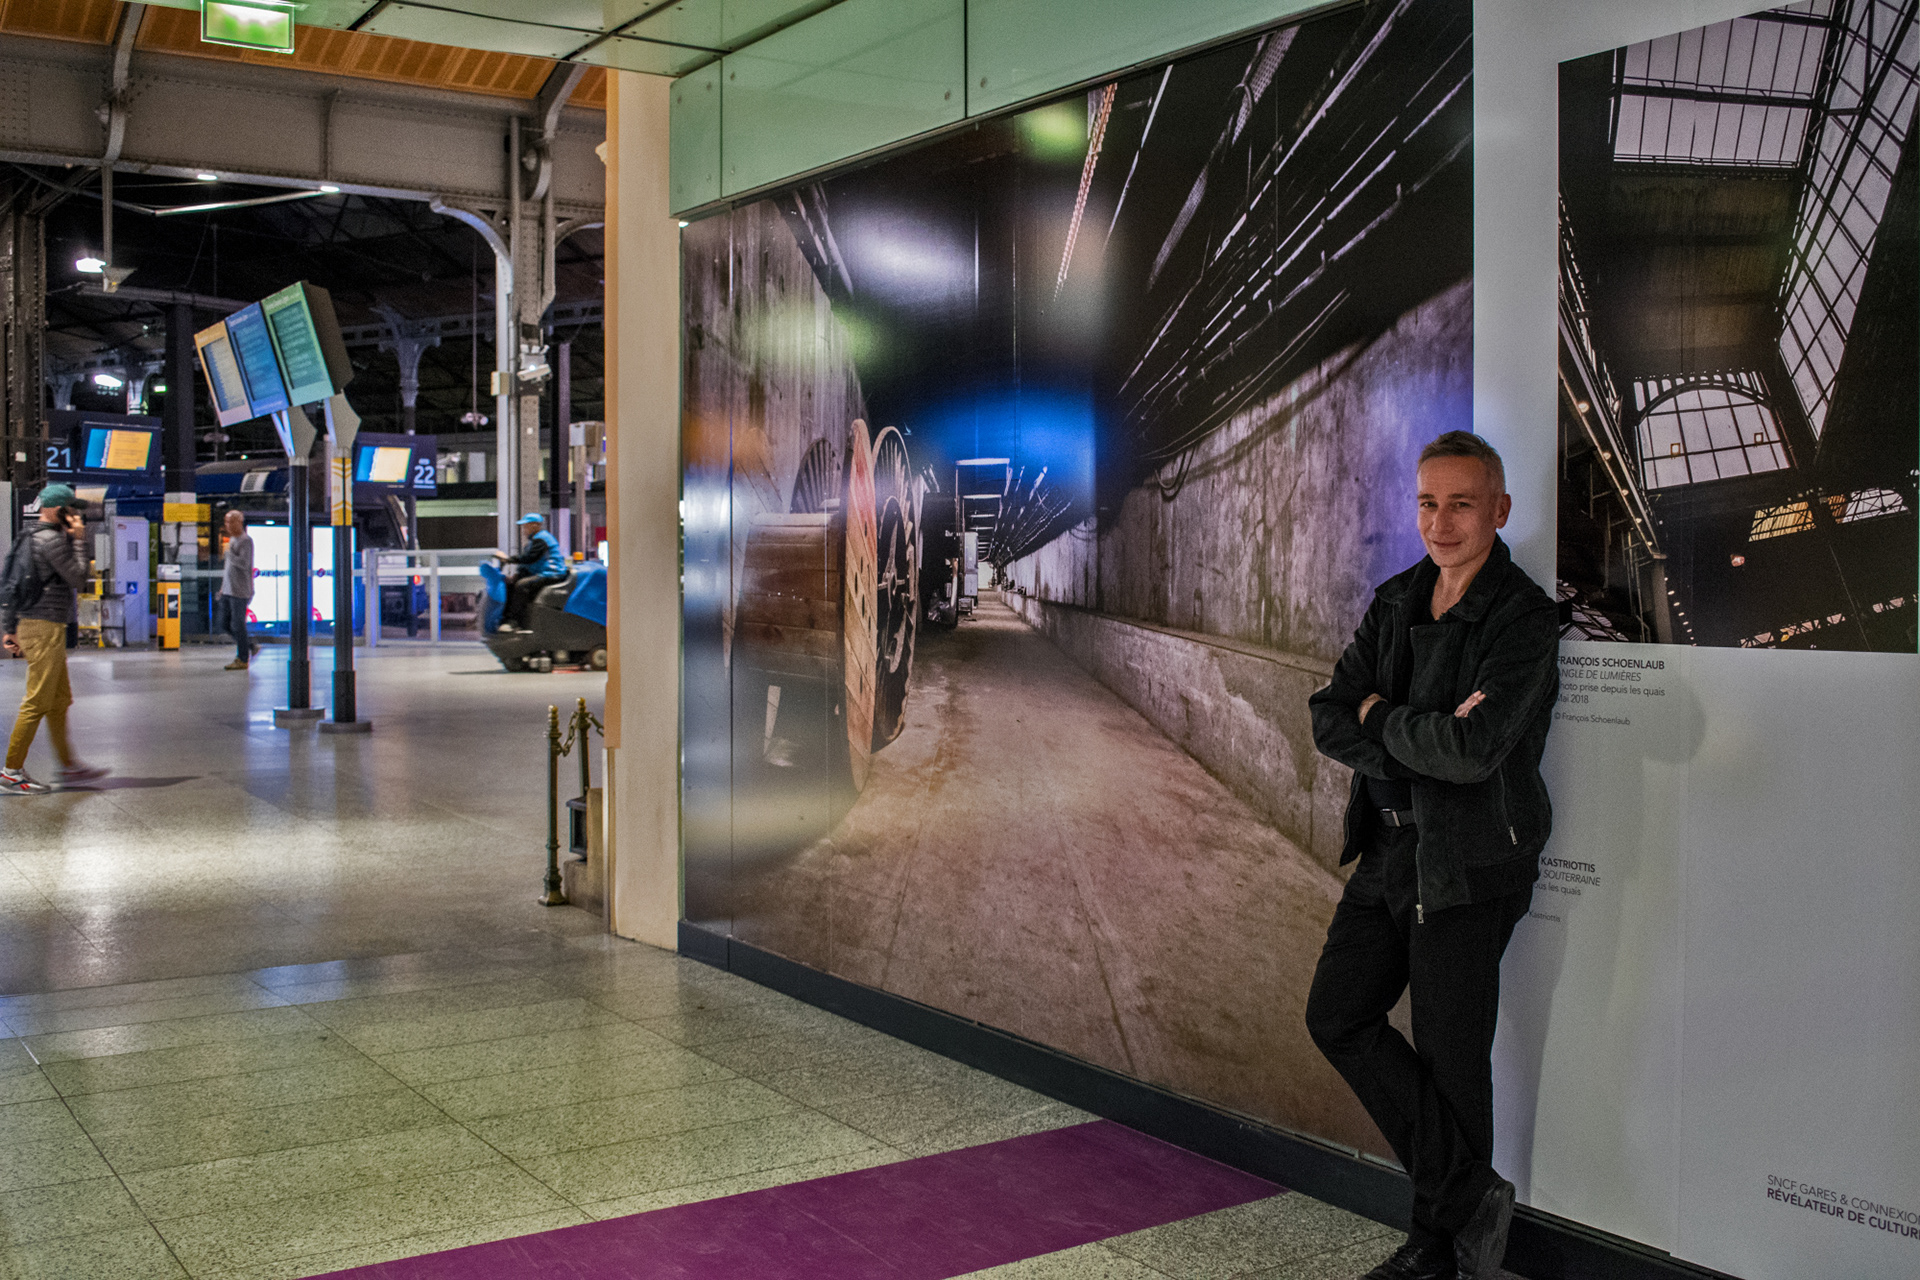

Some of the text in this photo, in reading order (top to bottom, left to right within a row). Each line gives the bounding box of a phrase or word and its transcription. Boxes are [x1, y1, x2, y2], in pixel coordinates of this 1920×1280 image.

[46, 446, 71, 468] 21
[414, 465, 435, 485] 22
[1602, 657, 1665, 670] SCHOENLAUB
[1560, 668, 1642, 681] NGLE DE LUMIÈRES
[1580, 683, 1599, 693] prise
[1600, 684, 1628, 695] depuis
[1630, 685, 1641, 694] les
[1643, 686, 1665, 697] quais
[1570, 694, 1589, 704] 2018
[1591, 714, 1631, 725] Schoenlaub
[1540, 856, 1596, 873] KASTRIOTTIS
[1543, 869, 1601, 887] SOUTERRAINE
[1548, 882, 1560, 893] les
[1560, 886, 1582, 896] quais
[1767, 1174, 1920, 1226] SNCF GARES & CONNEXIO
[1767, 1188, 1845, 1219] RÉVÉLATEUR
[1848, 1209, 1866, 1225] DE
